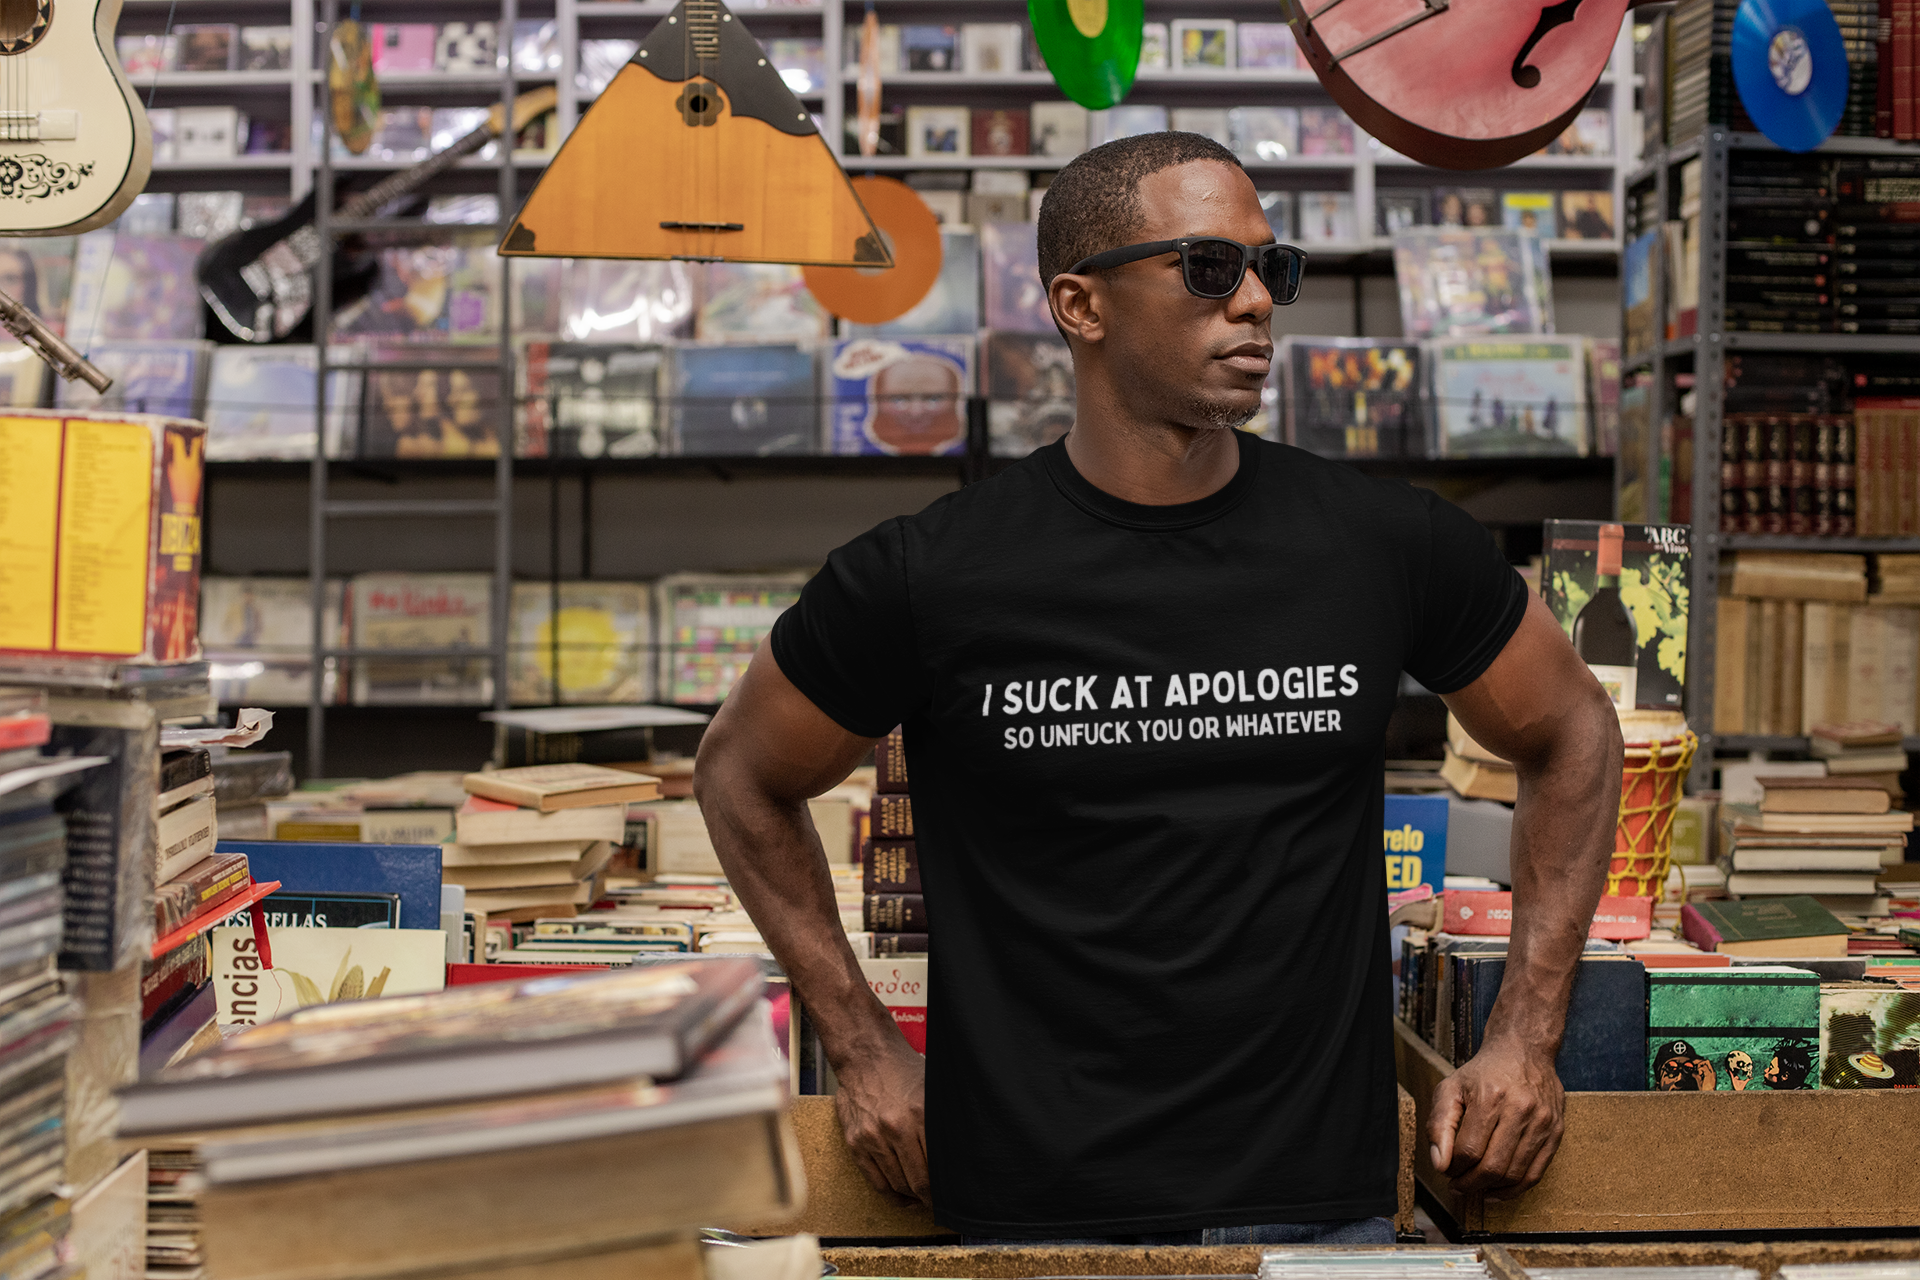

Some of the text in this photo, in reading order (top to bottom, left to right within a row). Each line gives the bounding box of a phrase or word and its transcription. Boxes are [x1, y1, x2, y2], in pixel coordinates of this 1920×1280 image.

[1647, 527, 1686, 545] ABC
[1663, 541, 1689, 554] Vino
[982, 664, 1359, 717] I SUCK AT APOLOGIES
[1004, 709, 1342, 750] SO UNFUCK YOU OR WHATEVER
[881, 797, 889, 835] AMADO
[888, 802, 896, 830] NERVO
[873, 847, 882, 884] AMADO
